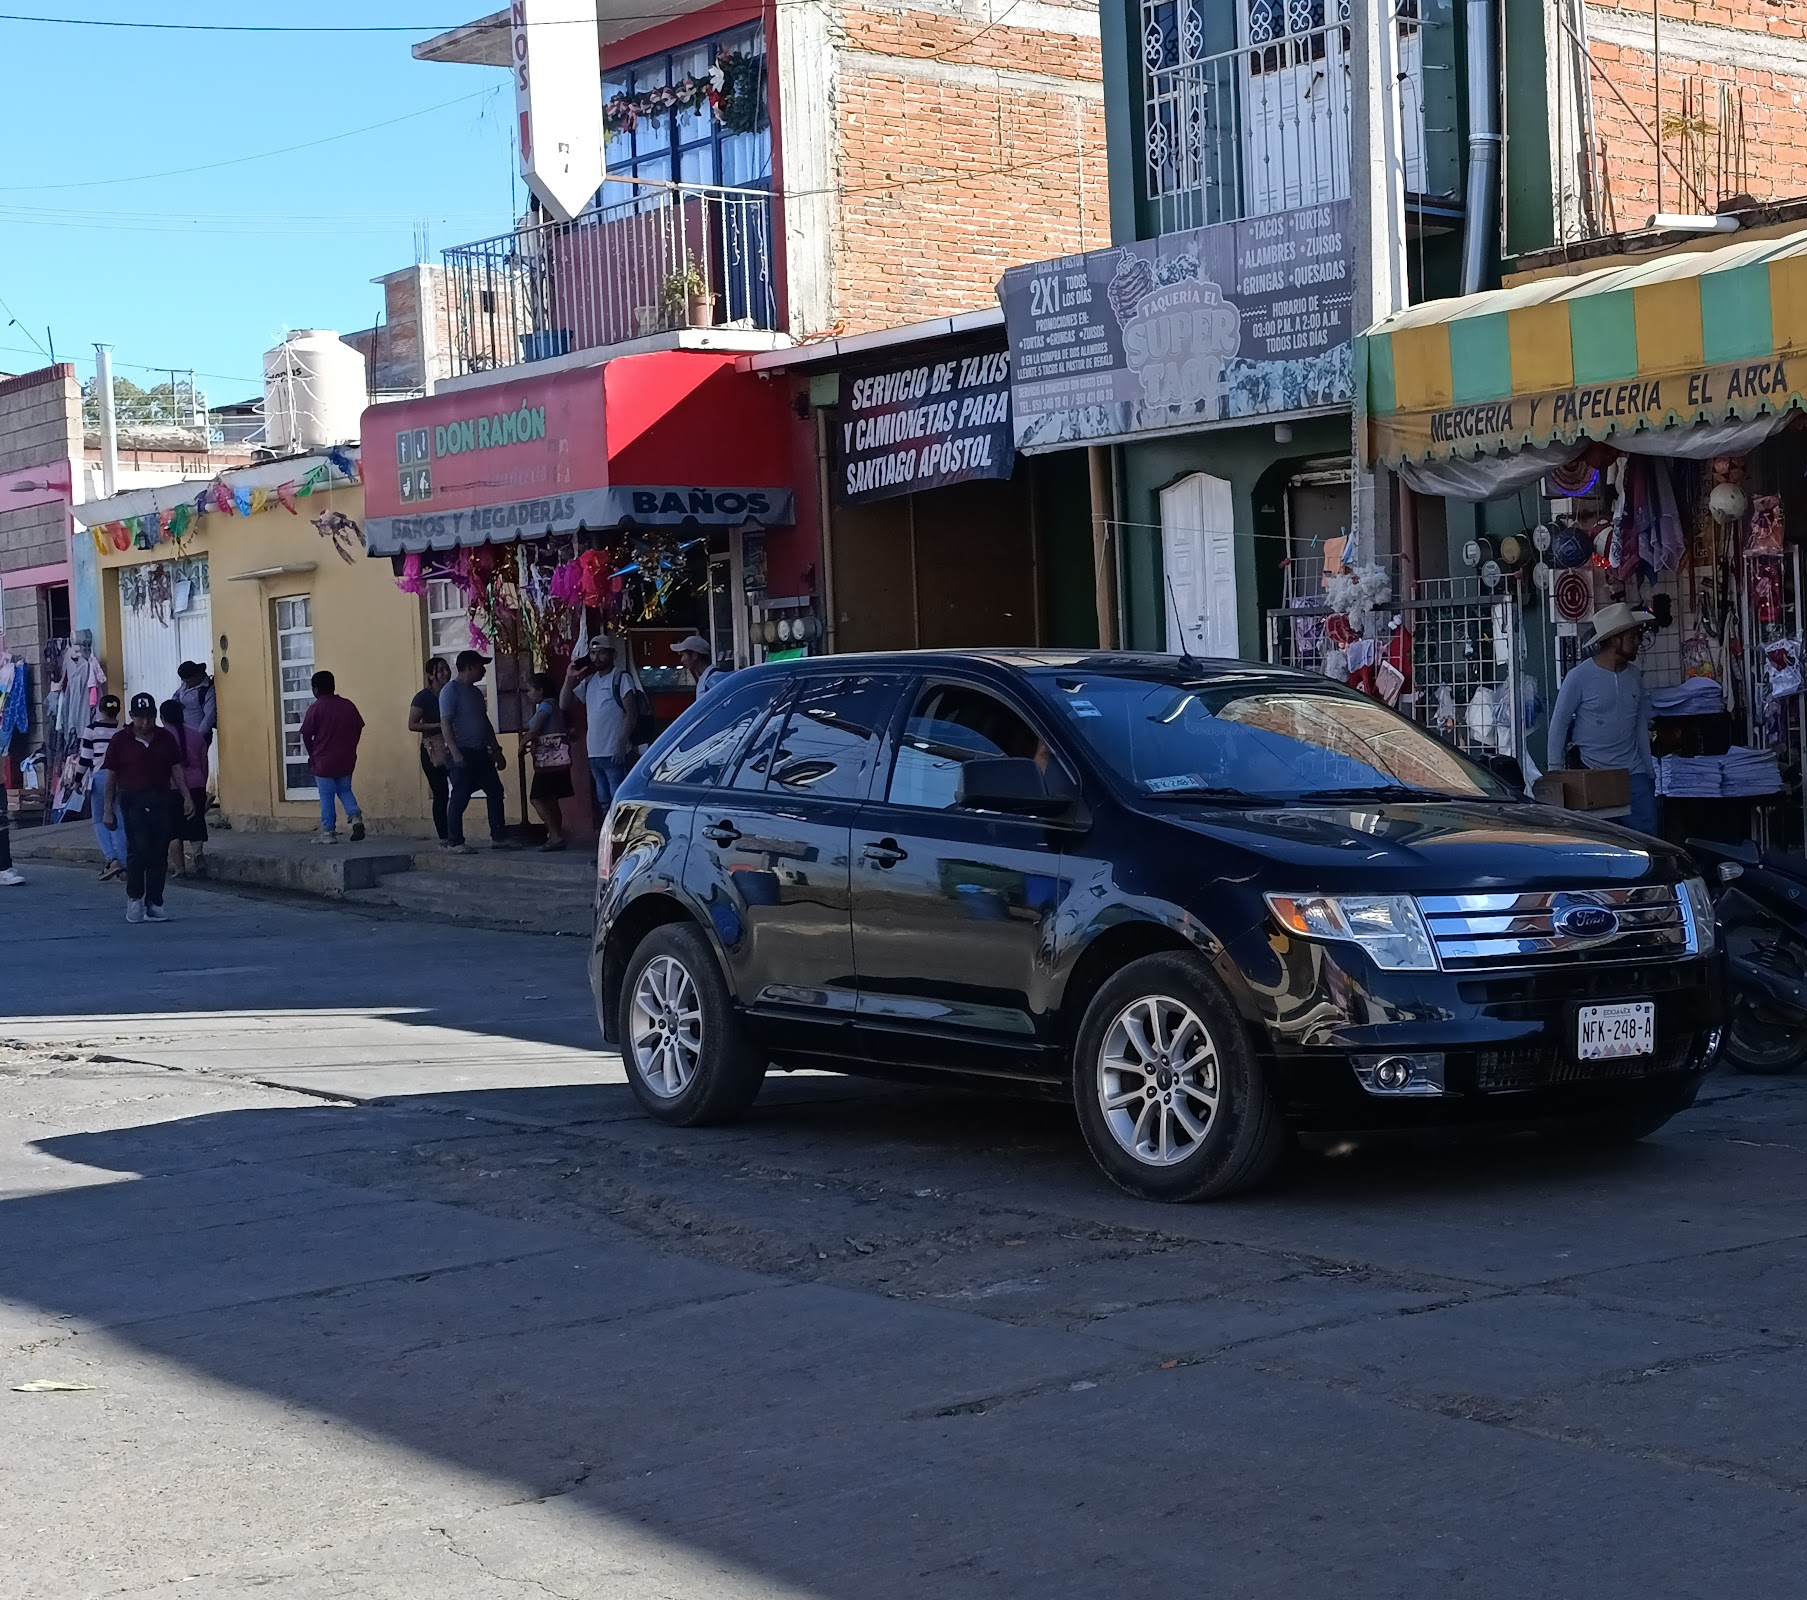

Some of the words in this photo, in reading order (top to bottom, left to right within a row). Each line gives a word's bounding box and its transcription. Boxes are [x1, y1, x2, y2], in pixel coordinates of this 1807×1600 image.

[1254, 216, 1284, 240] TACOS
[1294, 207, 1331, 232] TORTAS
[1053, 259, 1061, 271] AL
[1245, 241, 1296, 270] ALAMBRES
[1306, 232, 1342, 257] ZUISOS
[1065, 273, 1088, 290] TODOS
[1243, 270, 1285, 296] GRINGAS
[1294, 260, 1346, 289] QUESADAS
[1030, 275, 1060, 316] 2X1
[1062, 292, 1075, 307] LOS
[1076, 288, 1092, 304] DÍAS
[1142, 285, 1200, 317] TAQUERÍA
[1203, 291, 1218, 306] EL
[1272, 298, 1307, 318] HORARIO
[1308, 295, 1319, 312] DE
[1035, 314, 1077, 332] PROMOCIONES
[1127, 309, 1236, 367] SUPER
[1252, 320, 1276, 339] 03:00
[1277, 318, 1294, 335] P.M.
[1295, 316, 1301, 332] A
[1302, 312, 1321, 330] 2:00
[1322, 309, 1341, 327] A.M.
[1022, 335, 1045, 350] TORTAS
[1033, 353, 1040, 365] LA
[1061, 348, 1069, 360] DE
[1069, 347, 1080, 358] DOS
[1266, 334, 1292, 354] TODOS
[1293, 333, 1308, 350] LOS
[1309, 328, 1328, 347] DÍAS
[1085, 358, 1093, 368] DE
[1093, 354, 1114, 368] REGALO
[851, 366, 929, 411] SERVICIO
[930, 361, 956, 395] DE
[958, 351, 1010, 389] TAXIS
[1142, 355, 1221, 402] TACO
[1430, 403, 1513, 444] MERCERIA
[1529, 398, 1543, 426] Y
[1553, 380, 1662, 424] PAPELERIA
[1688, 374, 1714, 406] EL
[1727, 361, 1788, 399] ARCA
[435, 418, 475, 459] DON
[478, 399, 546, 449] RAMÓN
[843, 422, 853, 453] Y
[855, 400, 957, 451] CAMIONETAS
[958, 391, 1008, 429] PARA
[846, 449, 916, 495] SANTIAGO
[918, 434, 992, 478] APÓSTOL
[632, 487, 771, 515] BAÑOS
[392, 514, 445, 541] BAÑOS
[453, 512, 466, 534] Y
[470, 496, 576, 532] REGADERAS
[1576, 909, 1606, 927] Ford
[1582, 1016, 1651, 1044] NFK-248-A
